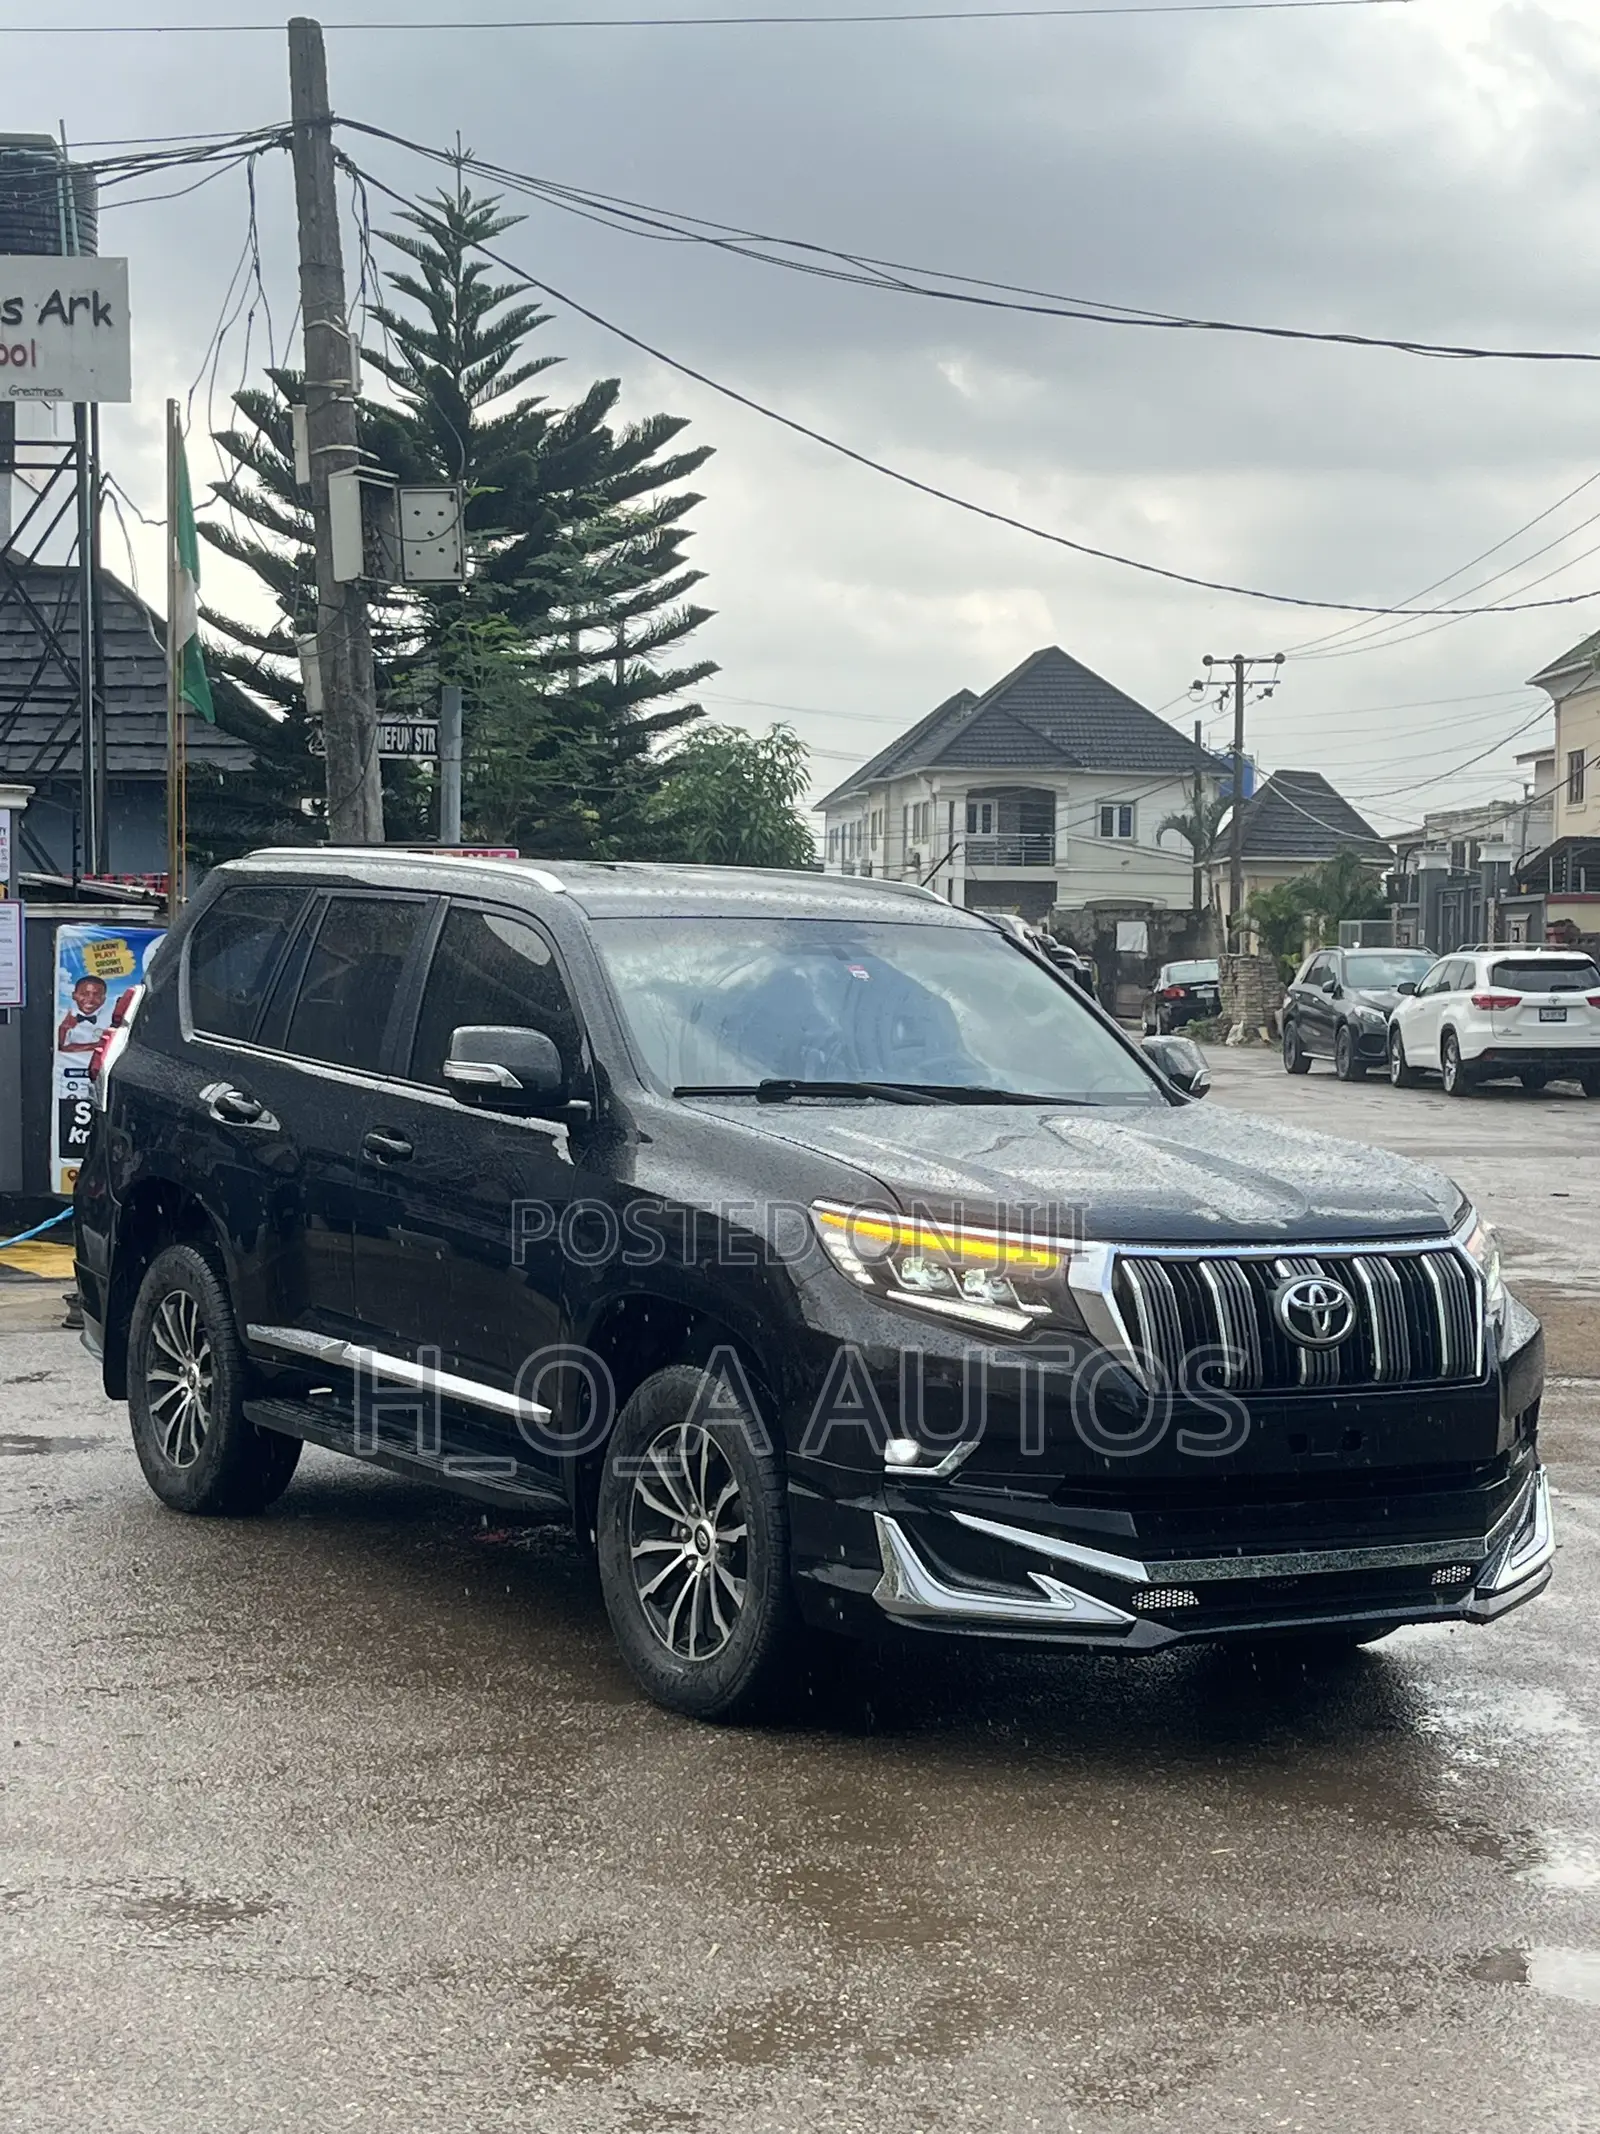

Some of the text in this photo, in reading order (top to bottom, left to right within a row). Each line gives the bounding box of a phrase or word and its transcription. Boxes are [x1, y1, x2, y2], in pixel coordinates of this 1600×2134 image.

[0, 289, 113, 327] s Ark
[8, 384, 64, 397] Greatness
[415, 727, 436, 752] STR
